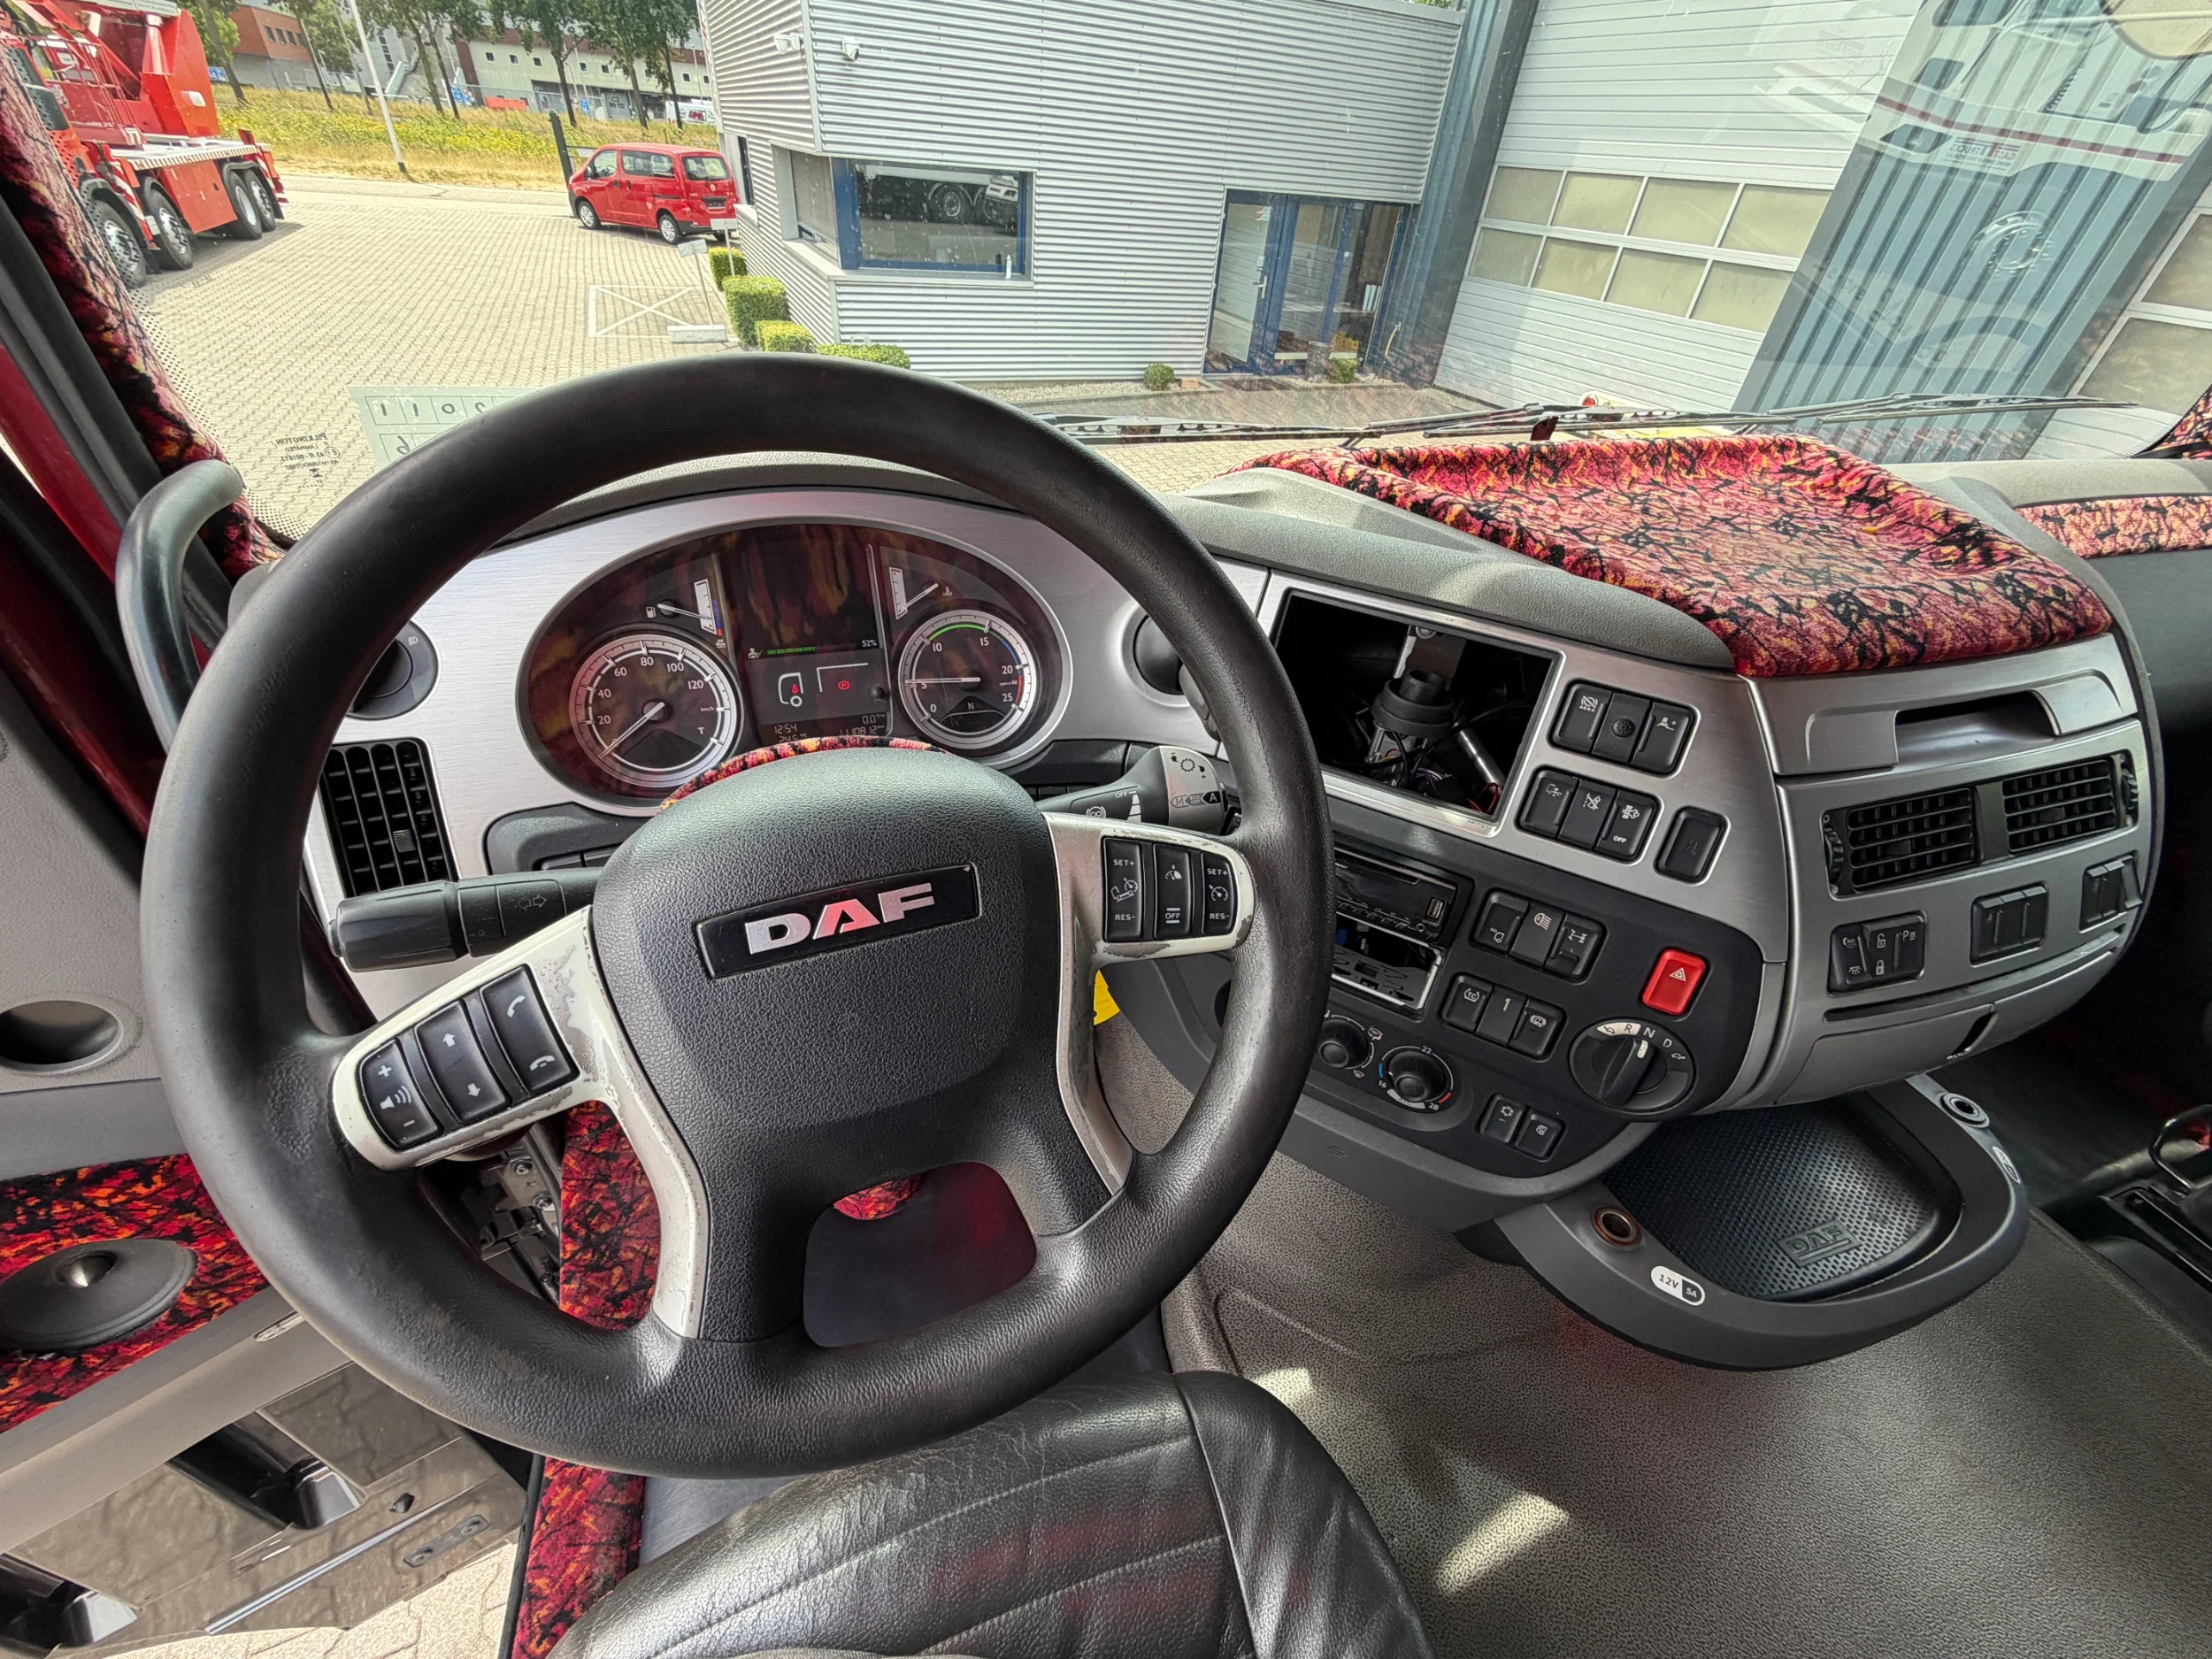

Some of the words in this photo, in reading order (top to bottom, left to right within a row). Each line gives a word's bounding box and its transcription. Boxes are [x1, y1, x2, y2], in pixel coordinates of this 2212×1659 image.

[979, 636, 989, 647] 15
[932, 642, 942, 652] 10
[640, 657, 654, 666] 80
[614, 667, 627, 677] 60
[666, 663, 684, 672] 100
[1001, 665, 1013, 674] 20
[687, 680, 704, 690] 120
[597, 688, 611, 698] 40
[1002, 693, 1013, 703] 25
[930, 703, 937, 713] 0
[967, 702, 974, 710] N
[597, 715, 611, 725] 20
[774, 723, 797, 734] 12:54
[1115, 790, 1127, 799] OFF
[1209, 793, 1217, 802] A
[744, 882, 935, 955] DAF
[1502, 997, 1511, 1011] 1
[1624, 1023, 1632, 1033] R
[1643, 1027, 1655, 1038] N
[1663, 1038, 1672, 1048] D
[1421, 1045, 1432, 1055] 22
[1379, 1079, 1387, 1088] 16
[1786, 1225, 1843, 1256] DAF
[1658, 1273, 1679, 1289] 12V
[1685, 1287, 1698, 1299] 5A
